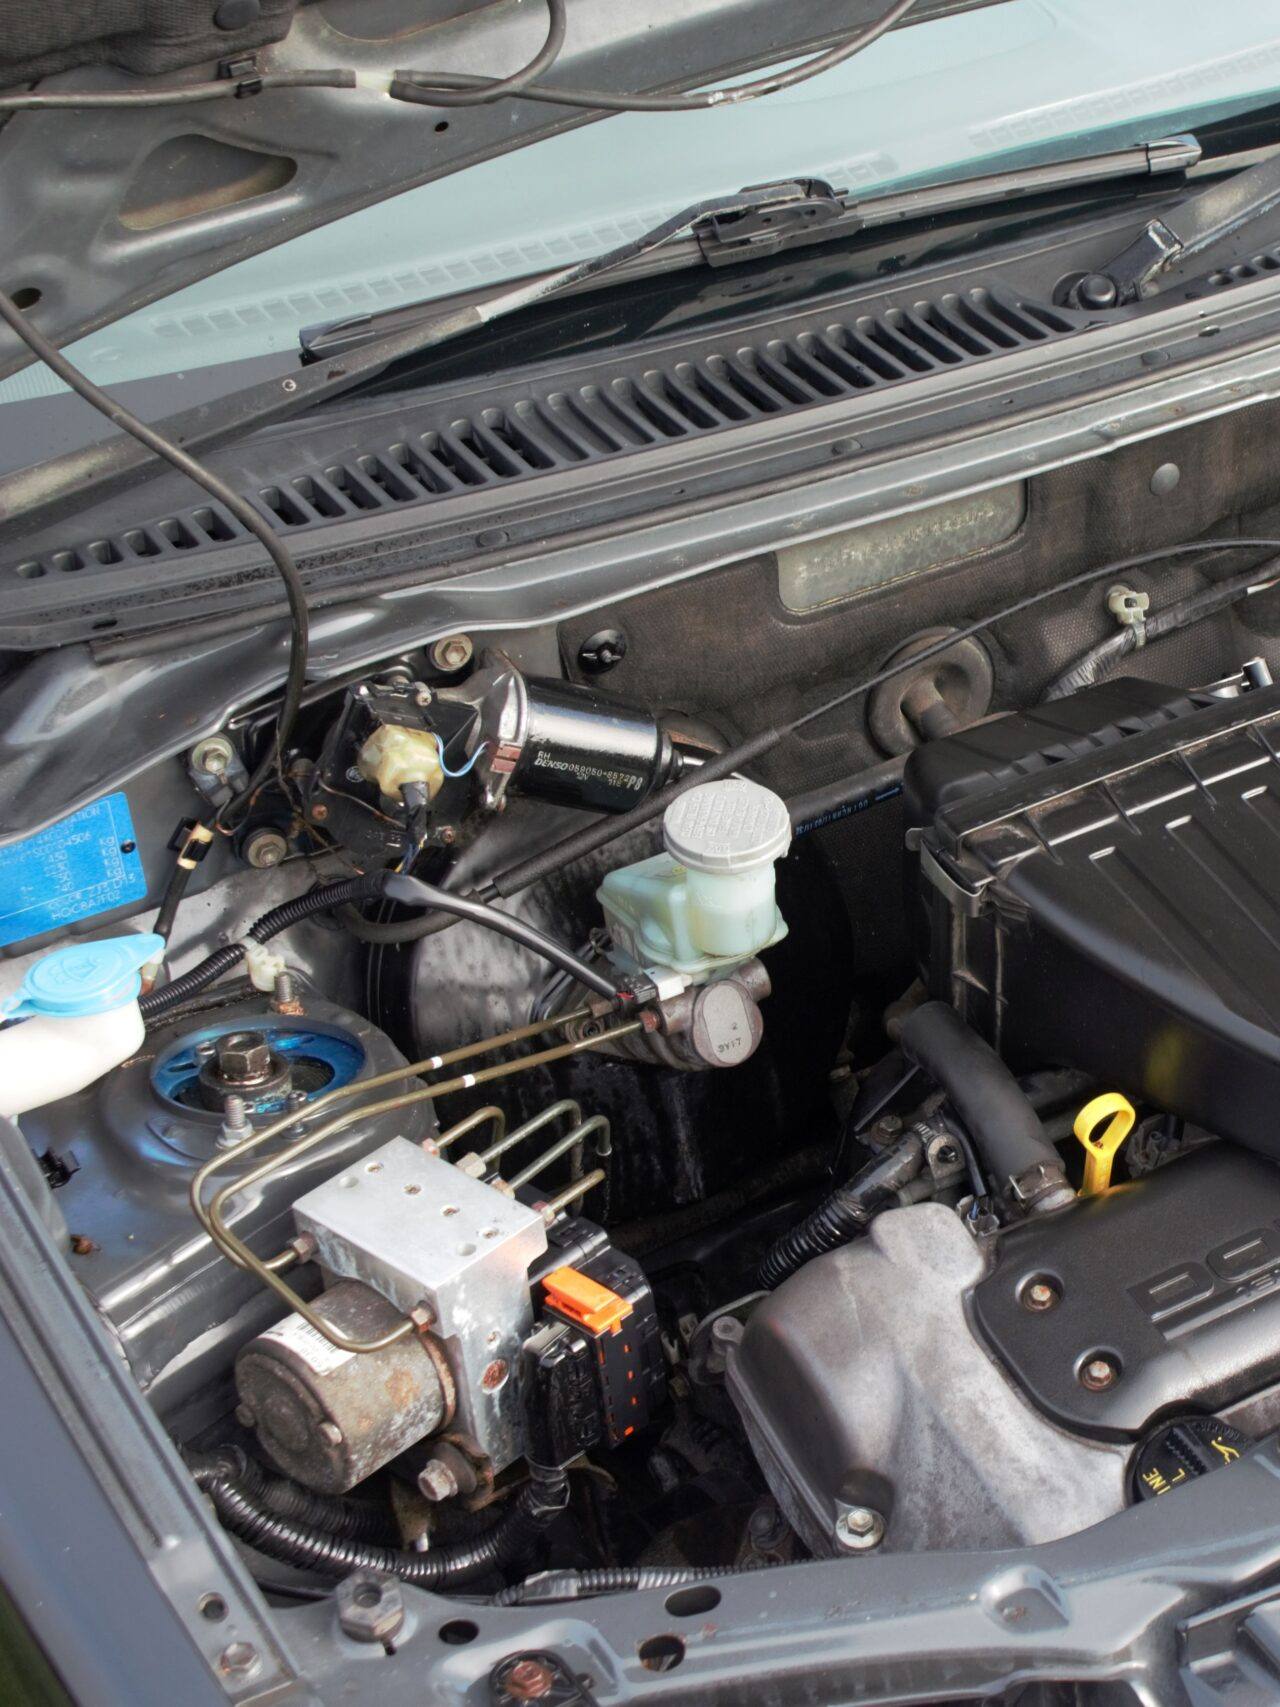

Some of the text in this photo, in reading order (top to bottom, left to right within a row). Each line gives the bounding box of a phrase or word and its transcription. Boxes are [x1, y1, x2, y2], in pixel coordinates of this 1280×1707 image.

[534, 758, 568, 771] DENSO
[1142, 1467, 1171, 1495] INE
[1172, 1467, 1186, 1482] L
